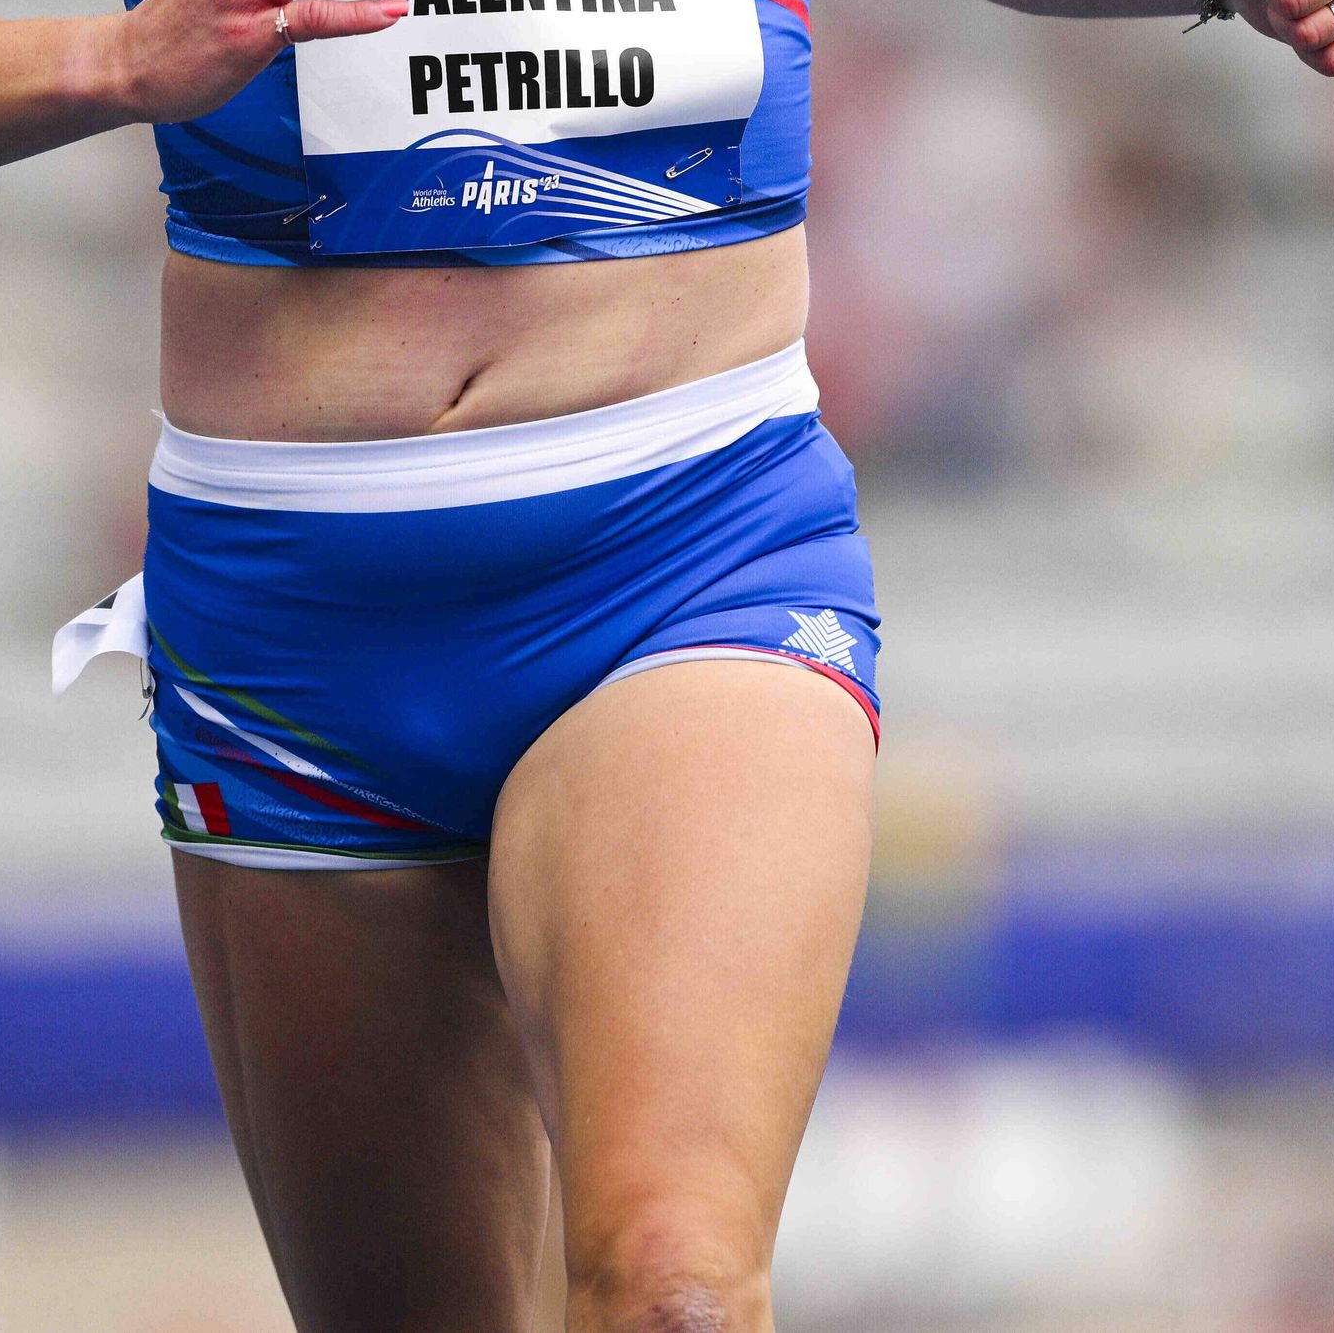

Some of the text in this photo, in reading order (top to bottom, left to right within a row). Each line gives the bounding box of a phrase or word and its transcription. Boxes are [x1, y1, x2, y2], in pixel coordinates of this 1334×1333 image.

[409, 47, 655, 115] PETRILLO
[412, 188, 448, 197] World Para
[412, 196, 456, 208] Athletics
